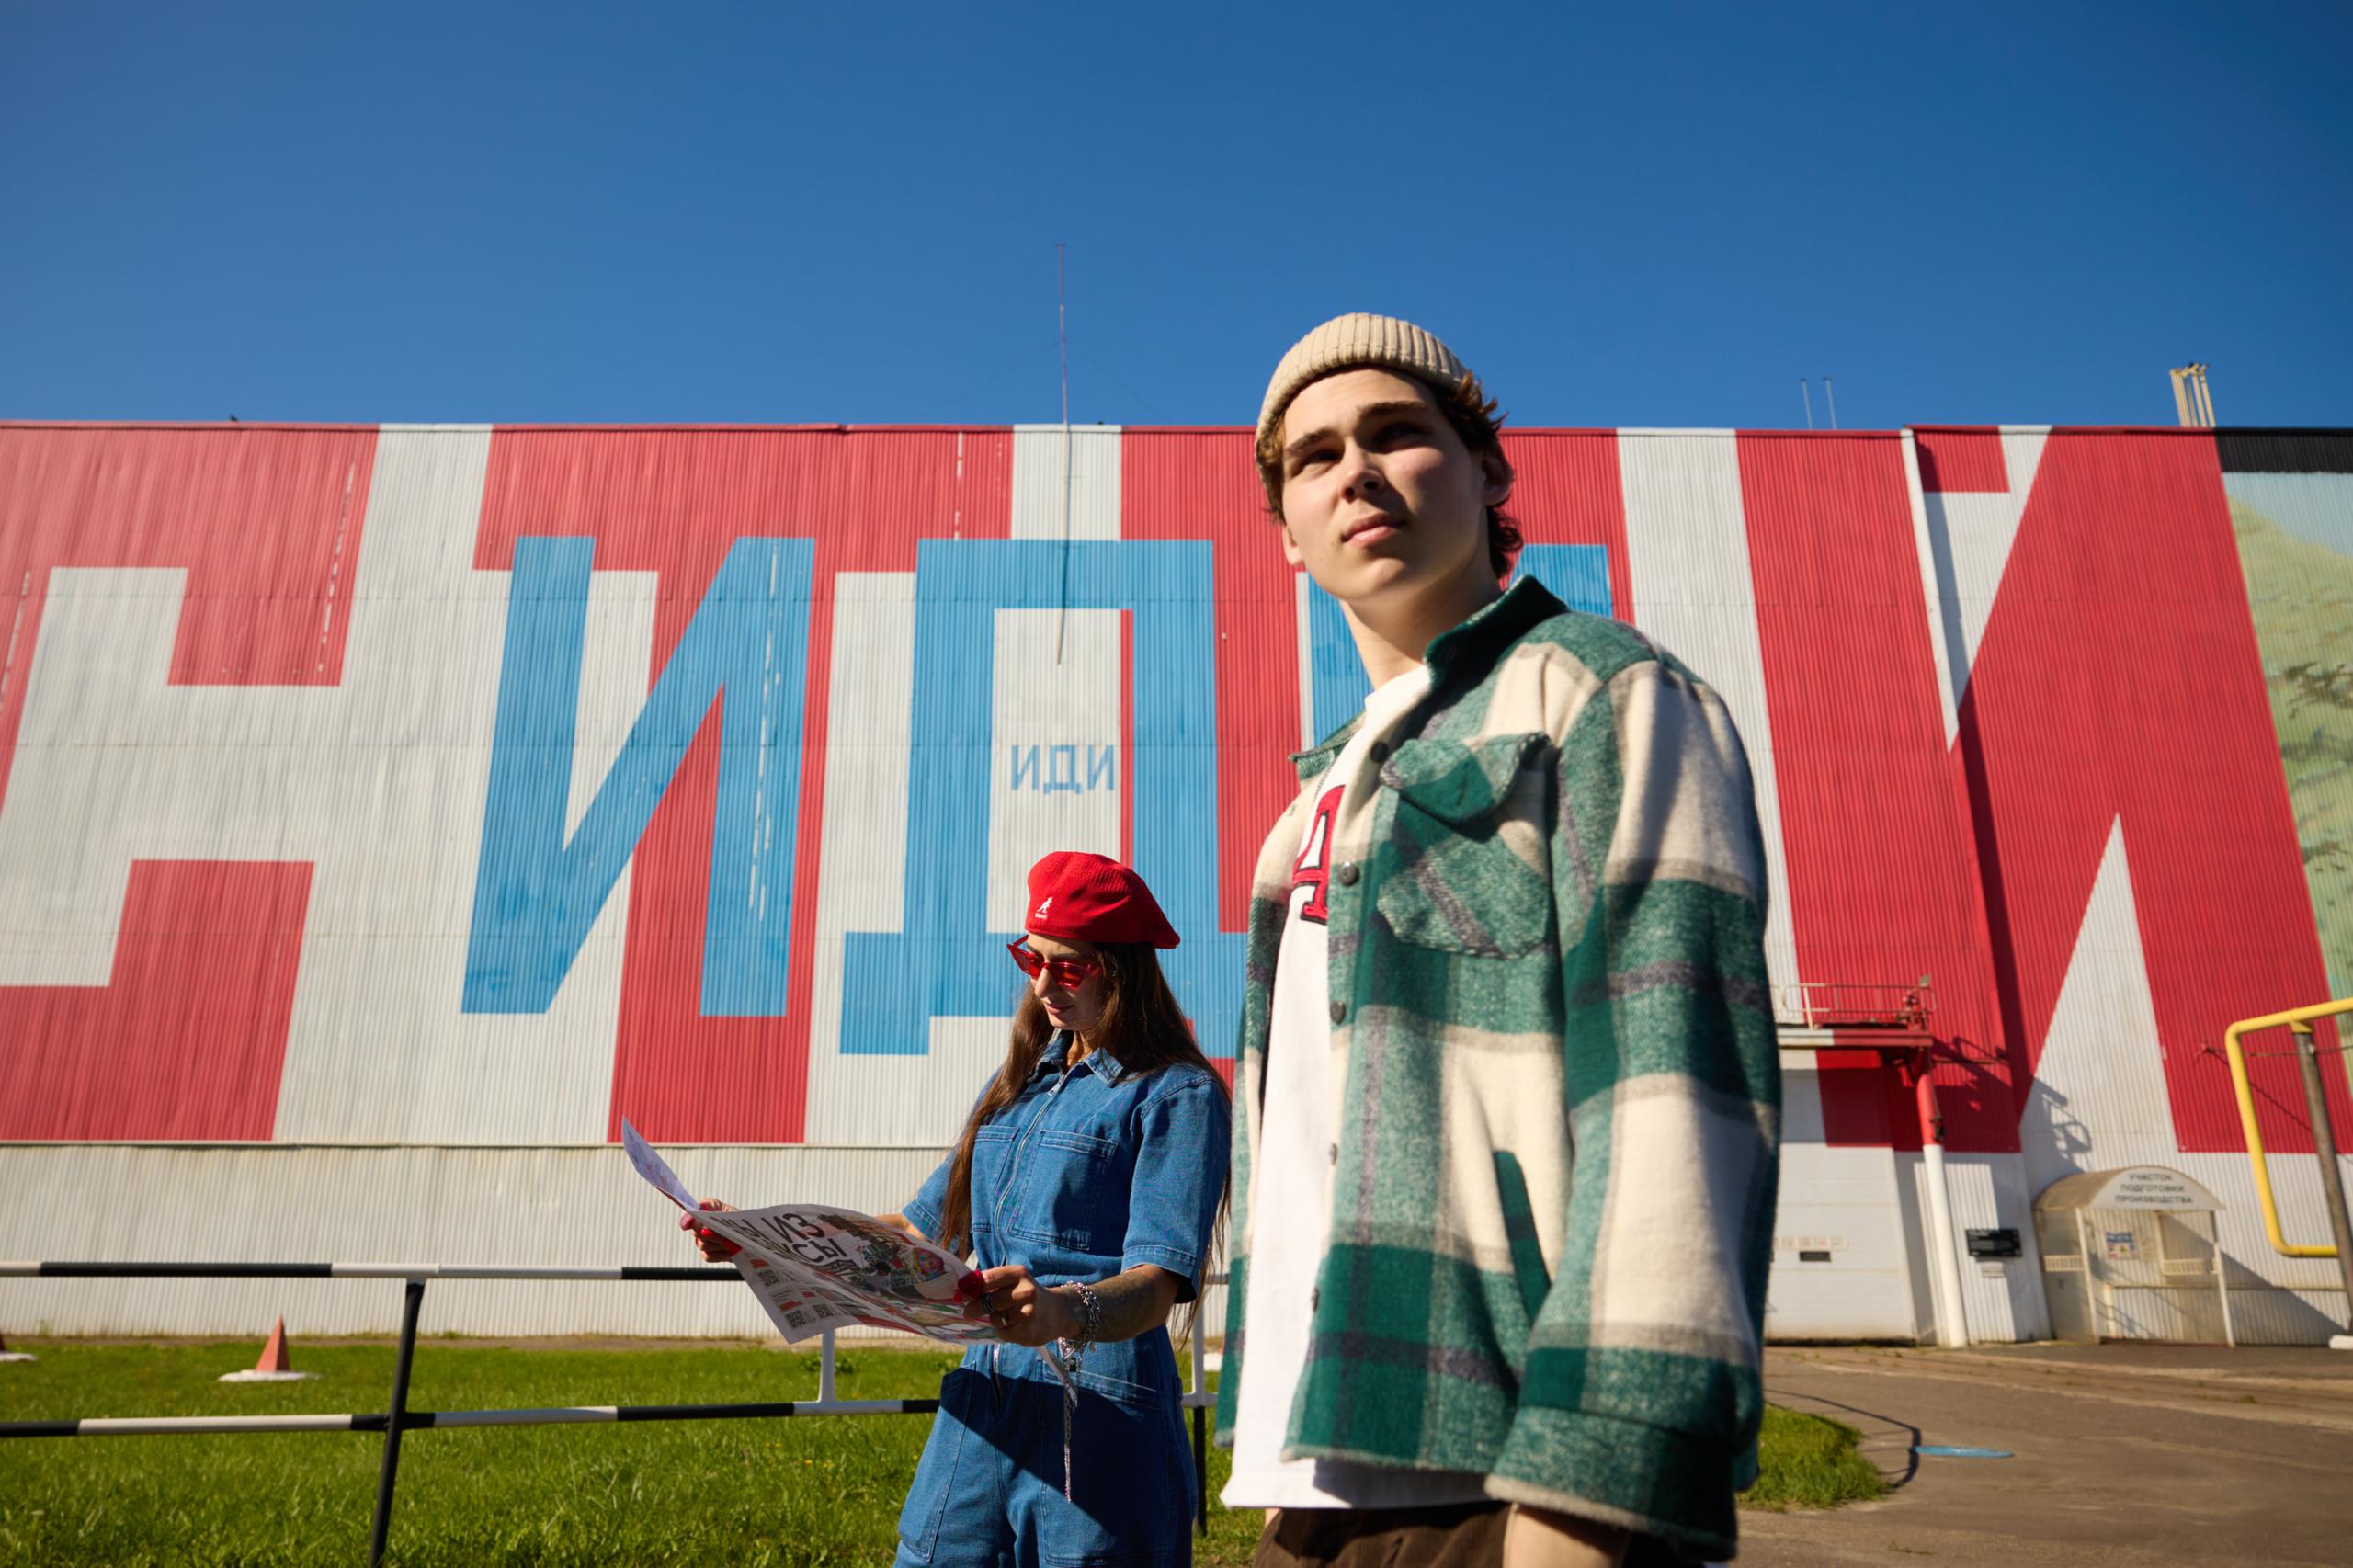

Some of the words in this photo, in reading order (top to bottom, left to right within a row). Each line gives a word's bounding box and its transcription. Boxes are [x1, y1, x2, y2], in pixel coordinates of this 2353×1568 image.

[1011, 744, 1114, 794] ИДИ
[2129, 1173, 2172, 1181] УЧАСТОК
[2120, 1183, 2185, 1193] ПОДГОТОВКИ
[2115, 1194, 2193, 1204] ПРОИЗВОДСТВА
[761, 1213, 825, 1243] ИЗ
